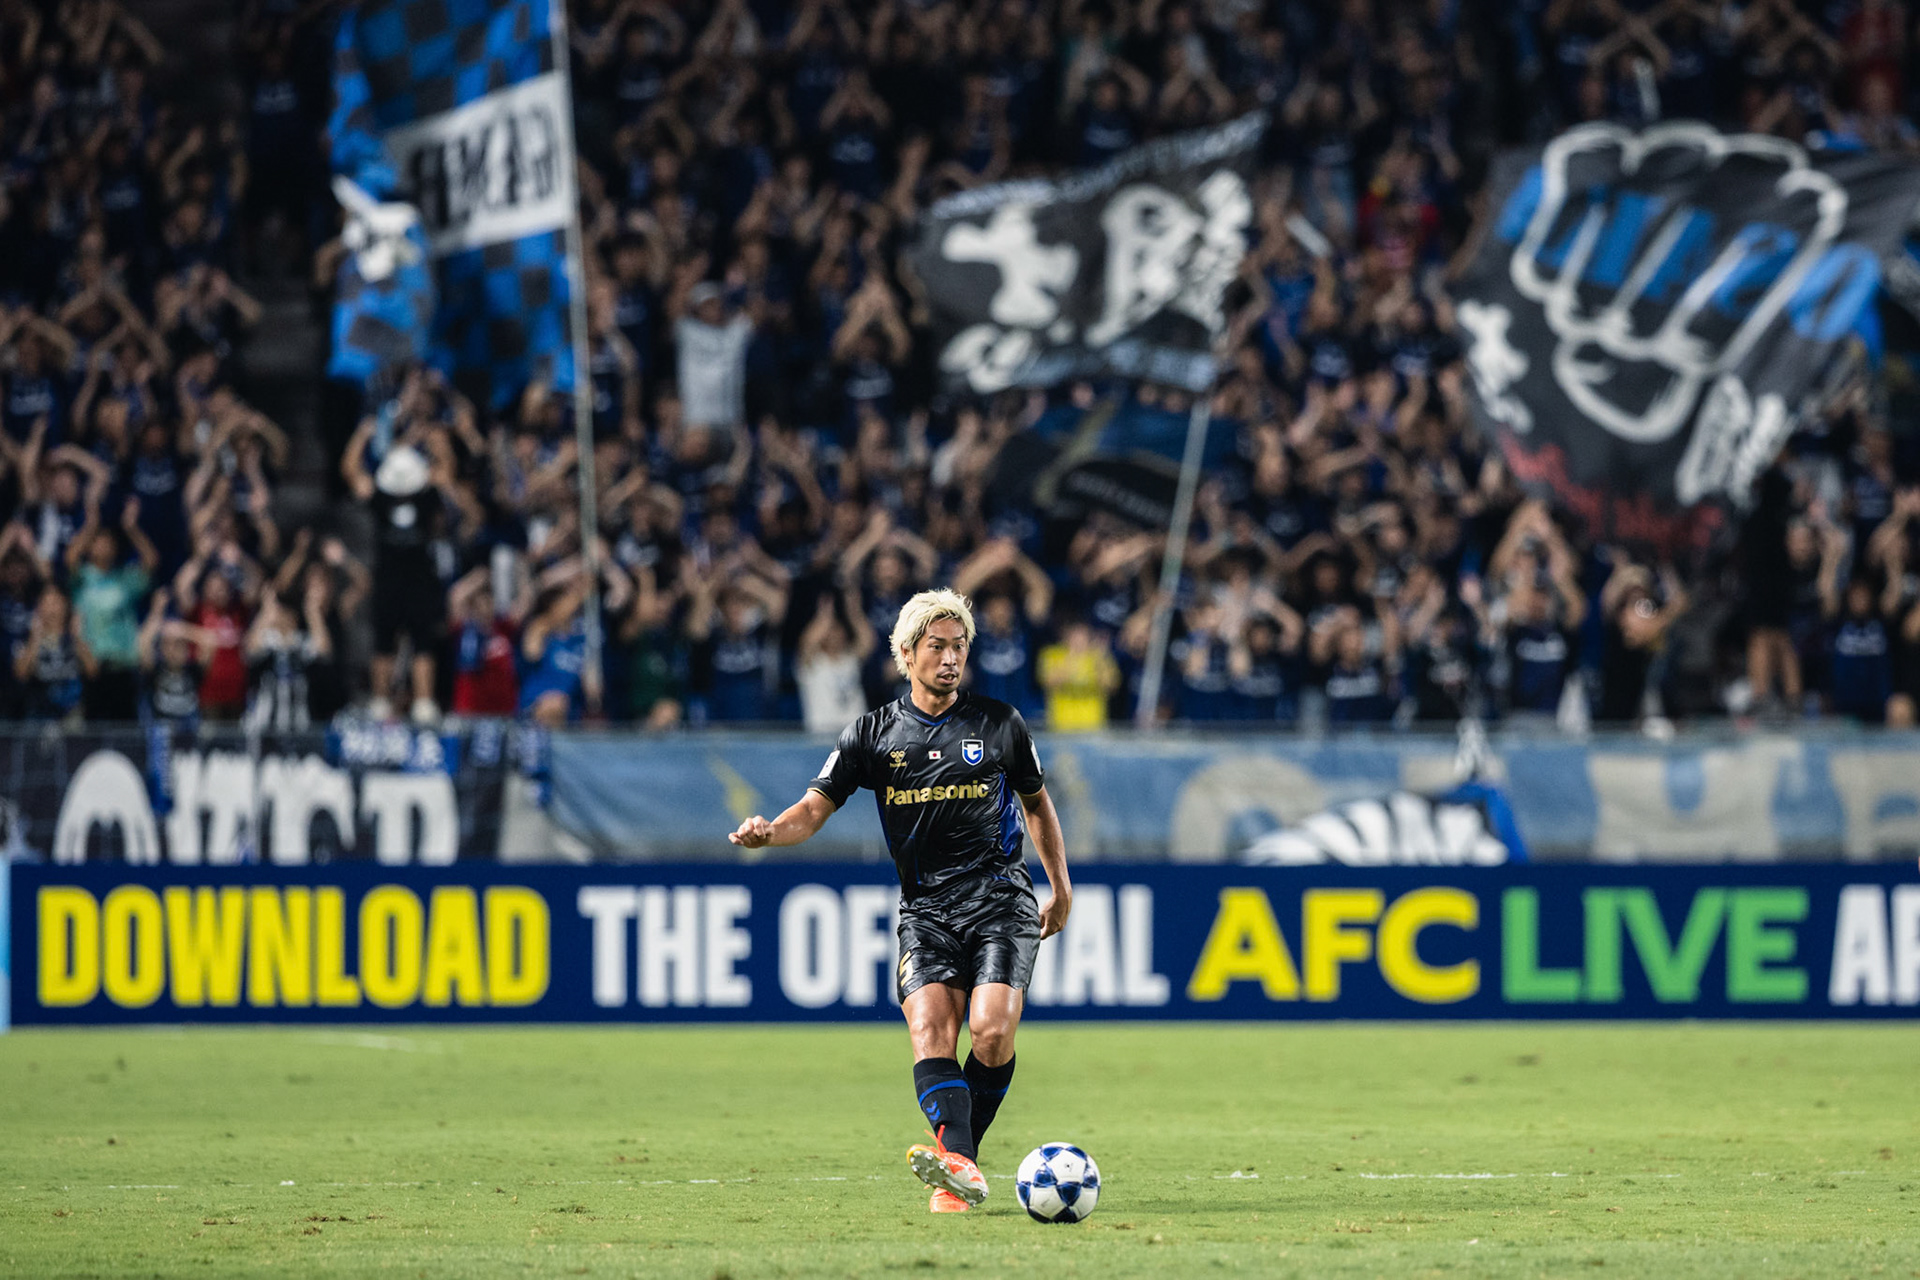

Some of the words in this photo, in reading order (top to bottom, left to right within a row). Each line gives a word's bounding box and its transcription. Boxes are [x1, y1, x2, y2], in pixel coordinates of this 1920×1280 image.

[885, 780, 990, 806] Panasonic
[37, 884, 550, 1007] DOWNLOAD
[578, 885, 752, 1006] THE
[778, 883, 1170, 1006] OFIAL
[1188, 886, 1481, 1003] AFC
[1501, 886, 1811, 1003] LIVE
